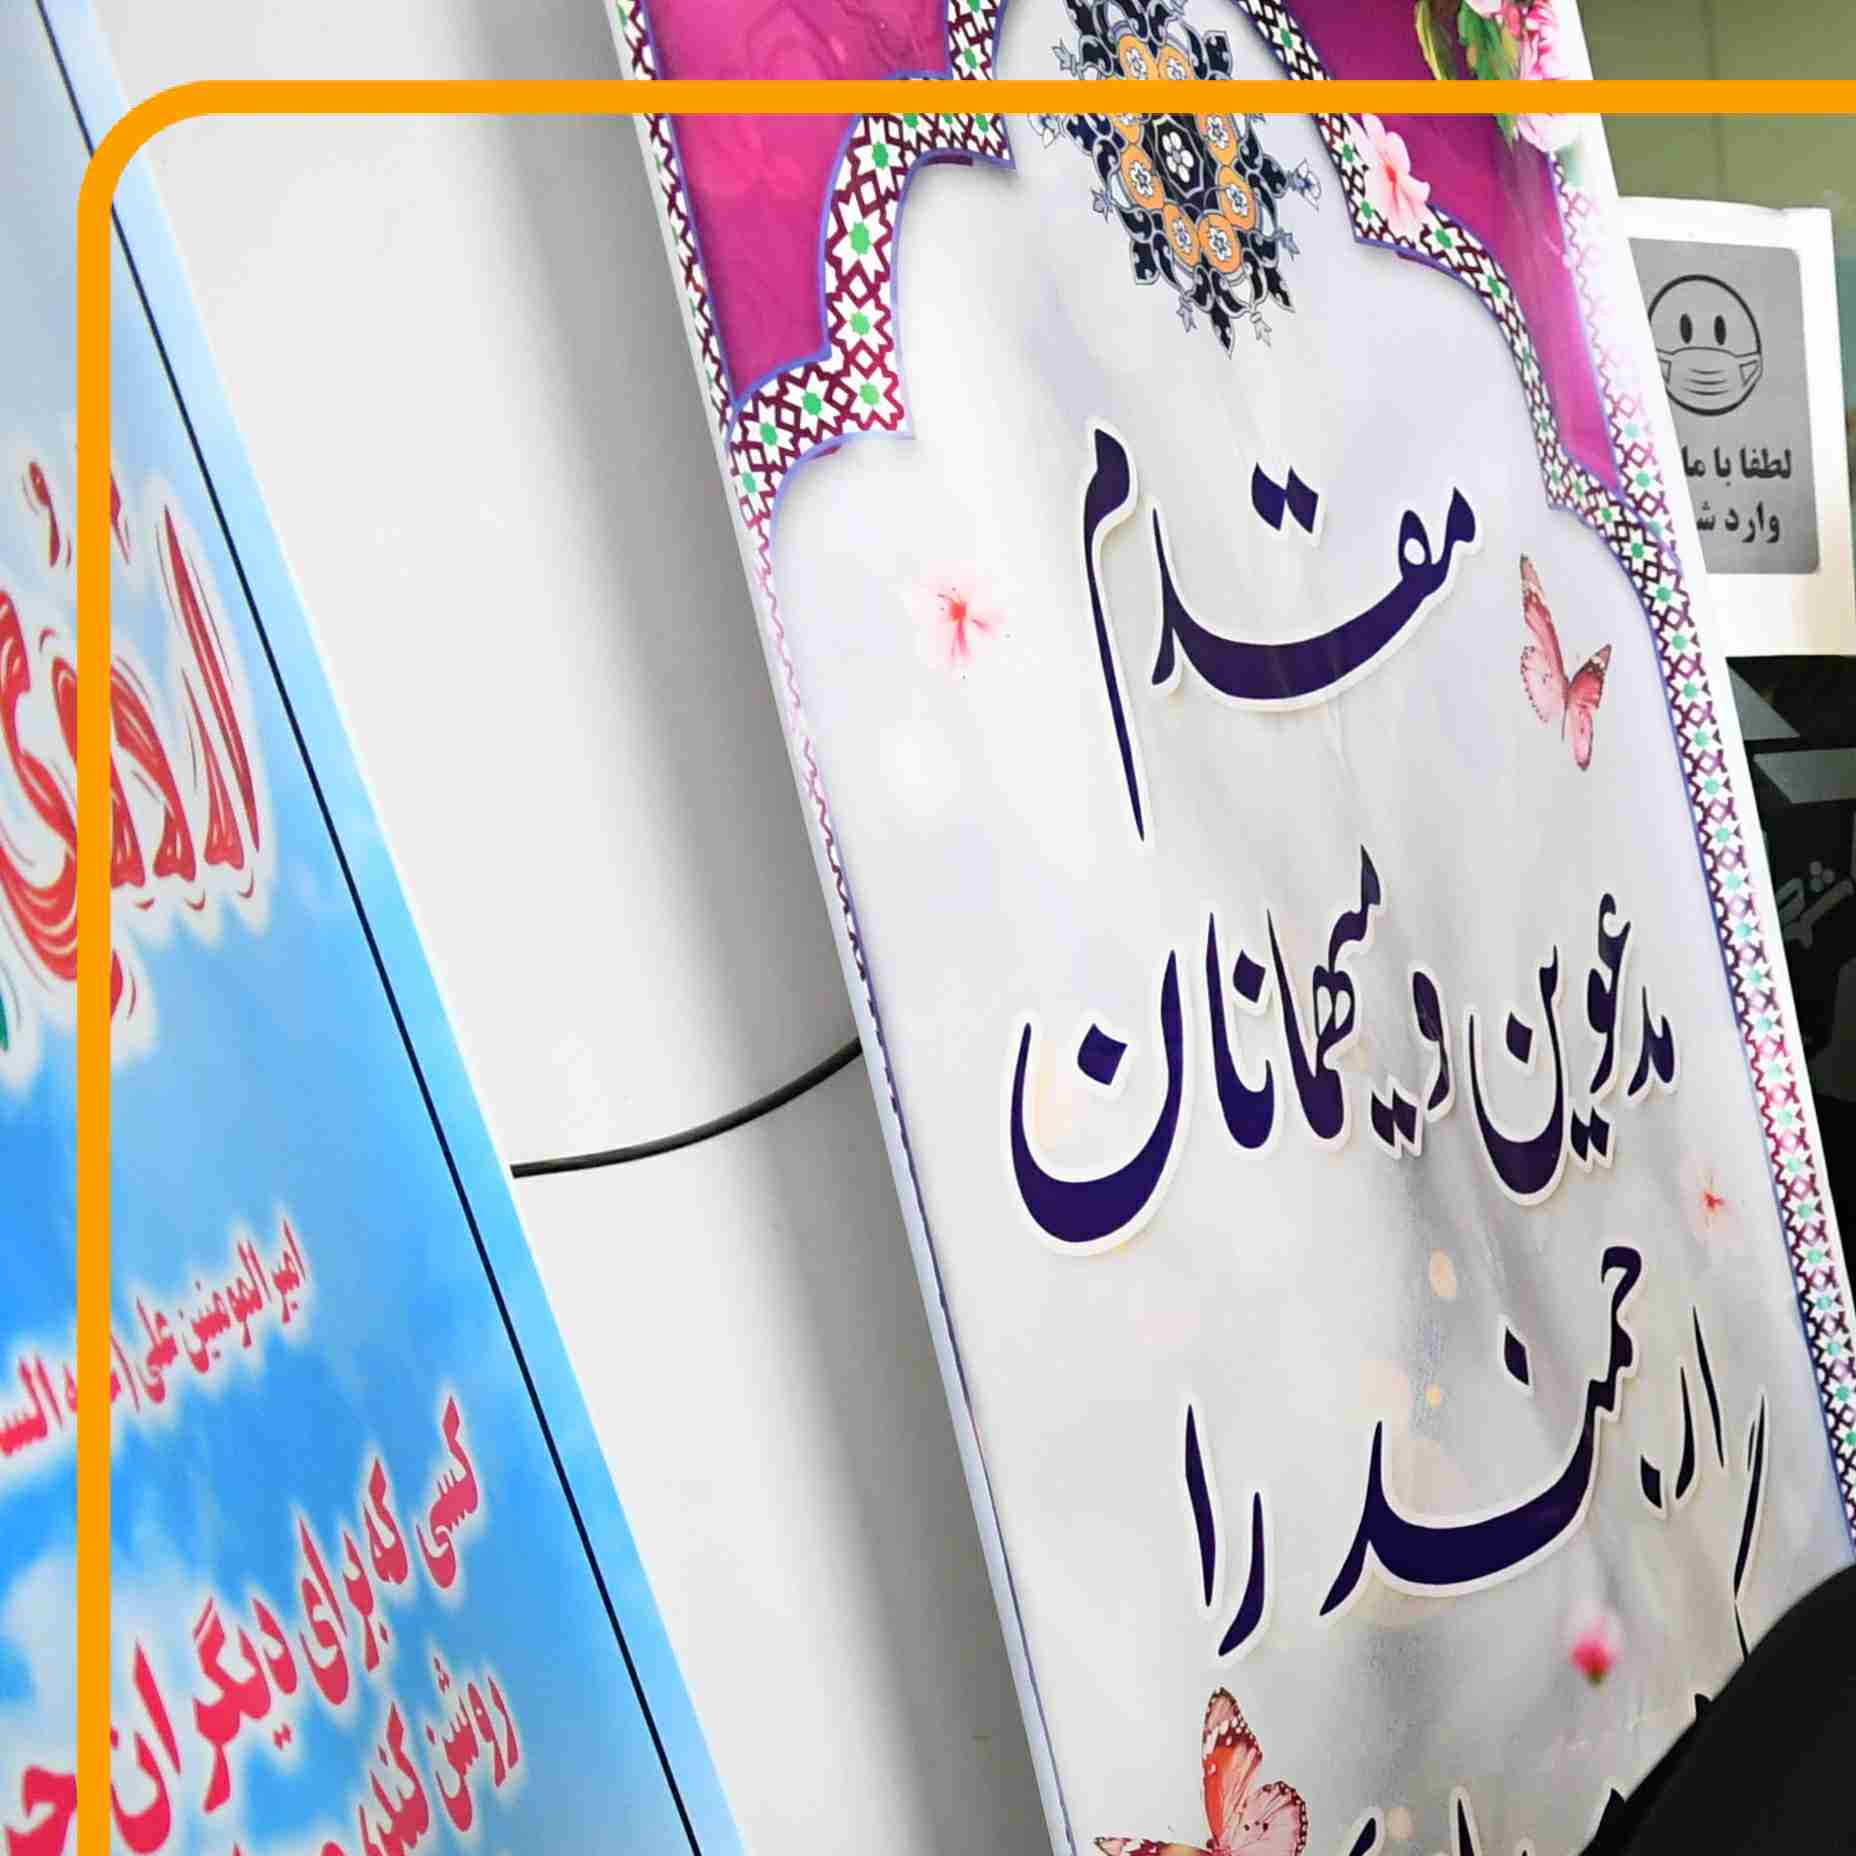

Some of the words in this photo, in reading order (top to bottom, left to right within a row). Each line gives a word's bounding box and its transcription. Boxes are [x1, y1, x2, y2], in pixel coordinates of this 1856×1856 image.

[1681, 445, 1706, 477] ما
[1713, 446, 1732, 487] با
[1725, 501, 1780, 544] وارد
[1740, 447, 1792, 479] لطفا
[1083, 428, 1477, 841] مقدم
[1411, 970, 1451, 1112] و
[1468, 892, 1675, 1194] مدعوین
[0, 1352, 63, 1457] الس
[136, 1295, 179, 1405] علی
[416, 1396, 479, 1589] کسی
[1319, 1245, 1725, 1616] ارجمند
[363, 1458, 409, 1585] که
[1184, 1404, 1265, 1658] را
[299, 1515, 389, 1706] برای
[109, 1596, 298, 1856] دیگران
[425, 1656, 520, 1832] روشن
